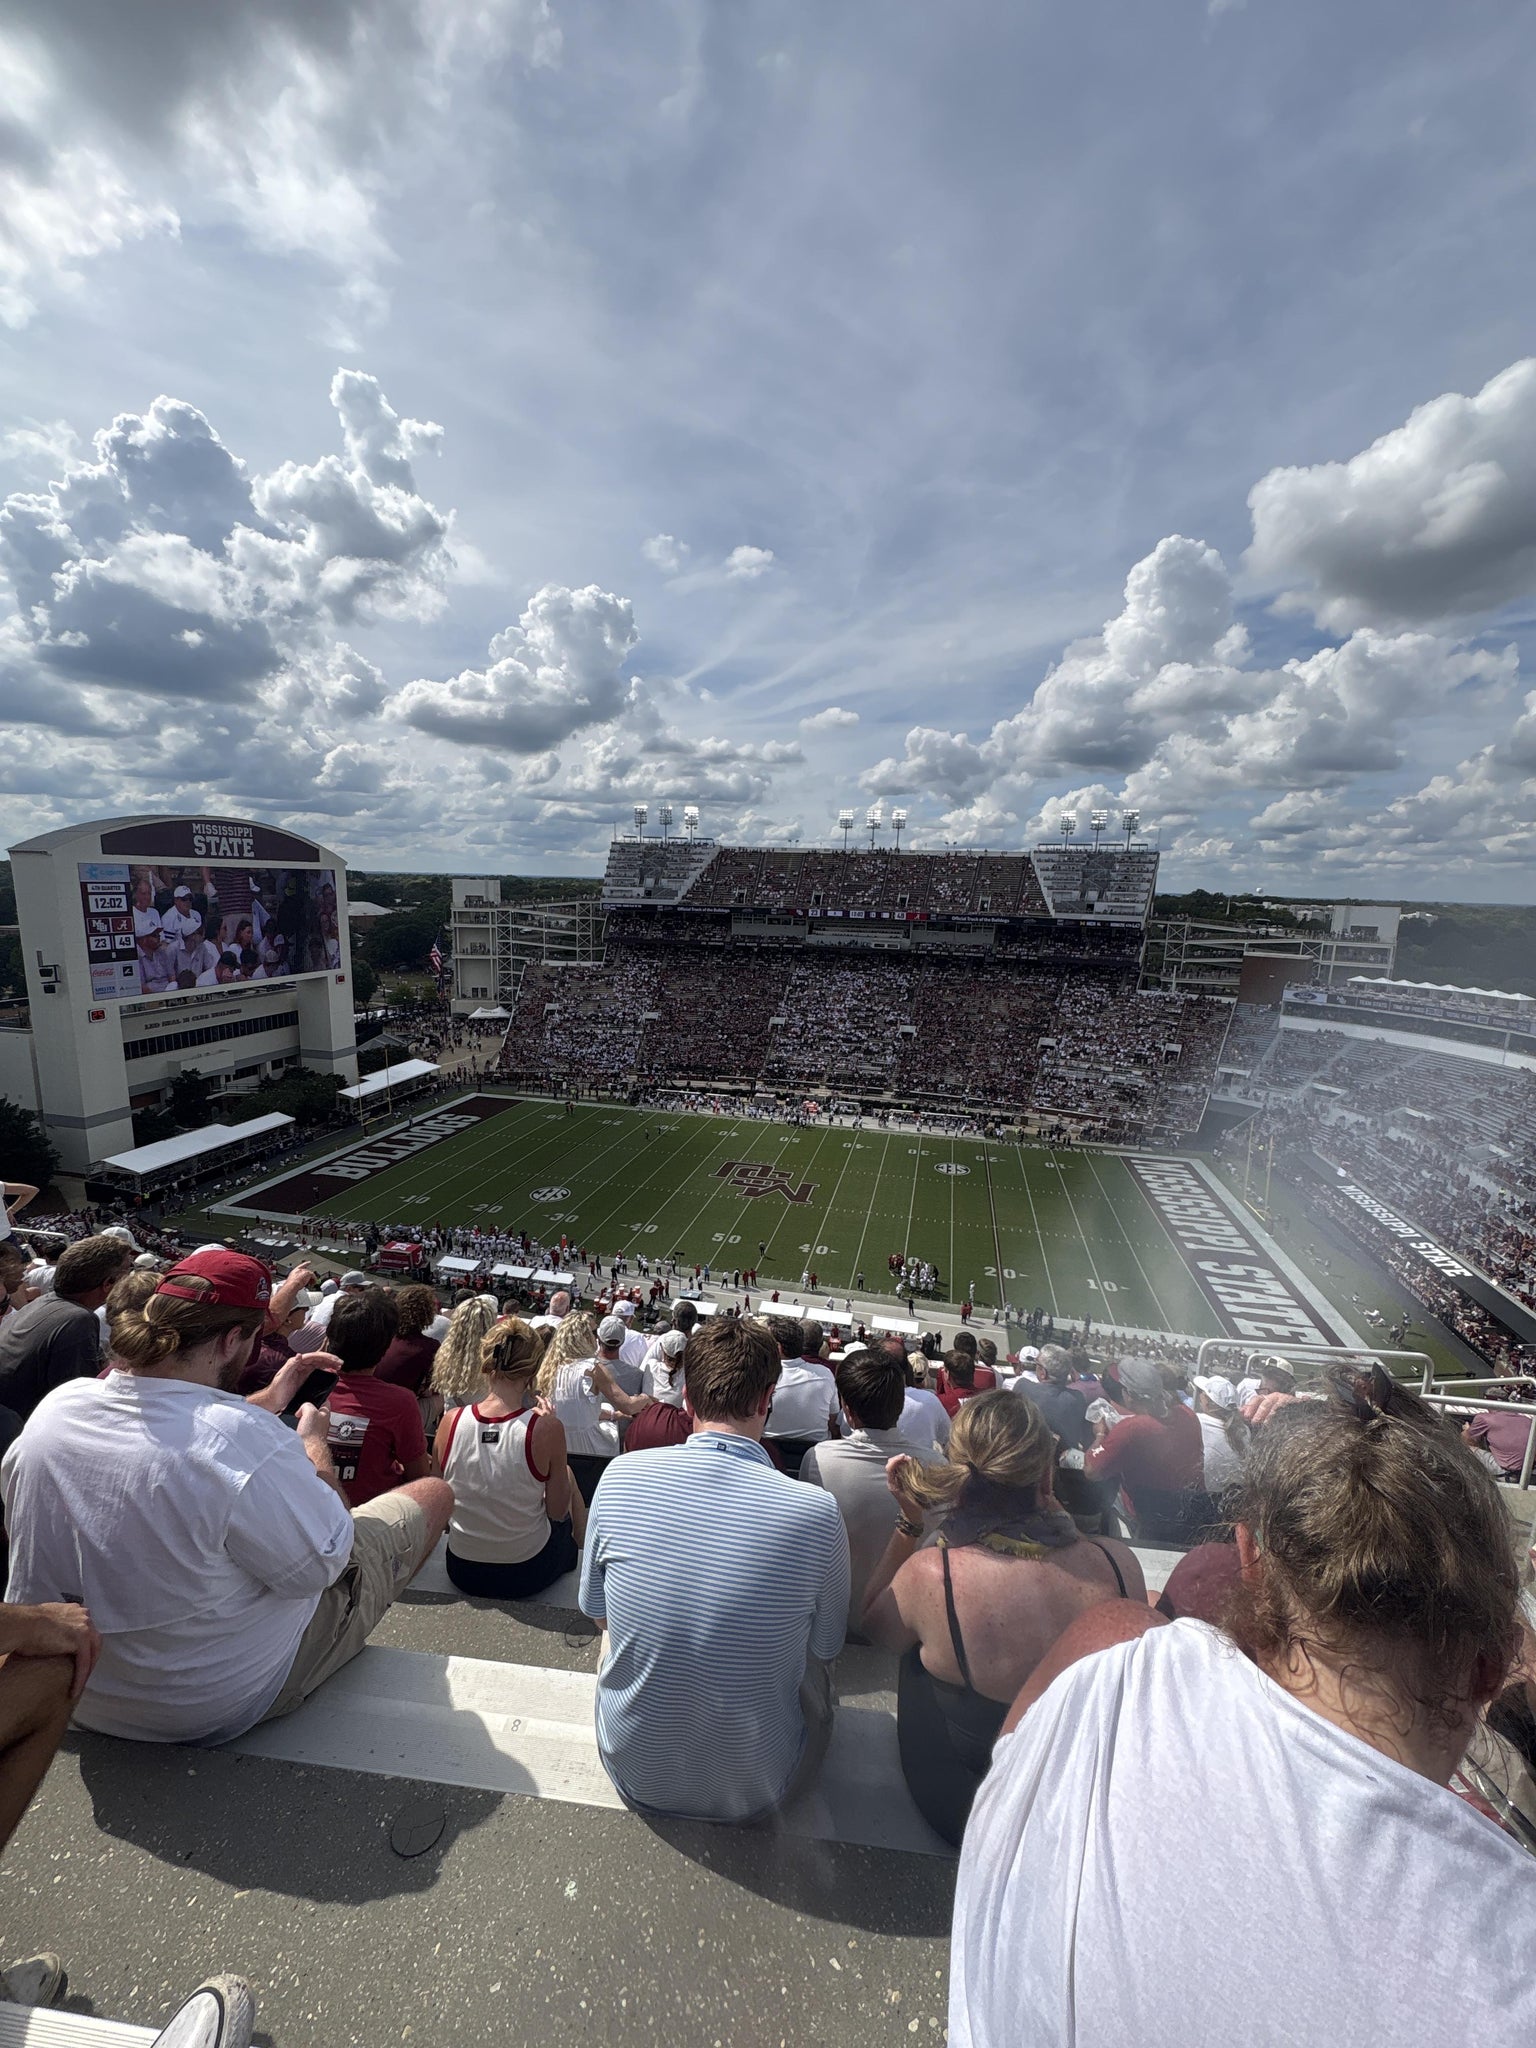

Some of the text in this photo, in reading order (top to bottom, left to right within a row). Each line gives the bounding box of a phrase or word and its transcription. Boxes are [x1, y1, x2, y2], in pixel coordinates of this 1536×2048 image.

[192, 823, 253, 837] MISSISSIPPI
[193, 835, 255, 857] STATE
[94, 898, 123, 909] 12:02
[95, 936, 131, 949] 23 49
[92, 1011, 104, 1020] 25
[310, 1113, 482, 1180] BULLDOGS
[472, 1203, 504, 1213] 20
[550, 1213, 580, 1223] 30
[629, 1222, 659, 1234] 40
[1336, 1185, 1474, 1278] MISSISSIPPI STATE
[711, 1232, 742, 1244] 50
[798, 1243, 830, 1255] 40
[1130, 1159, 1331, 1346] MISSISSIPPI STATE
[984, 1266, 1017, 1279] 20
[1086, 1278, 1119, 1292] 10
[511, 1718, 522, 1732] 8
